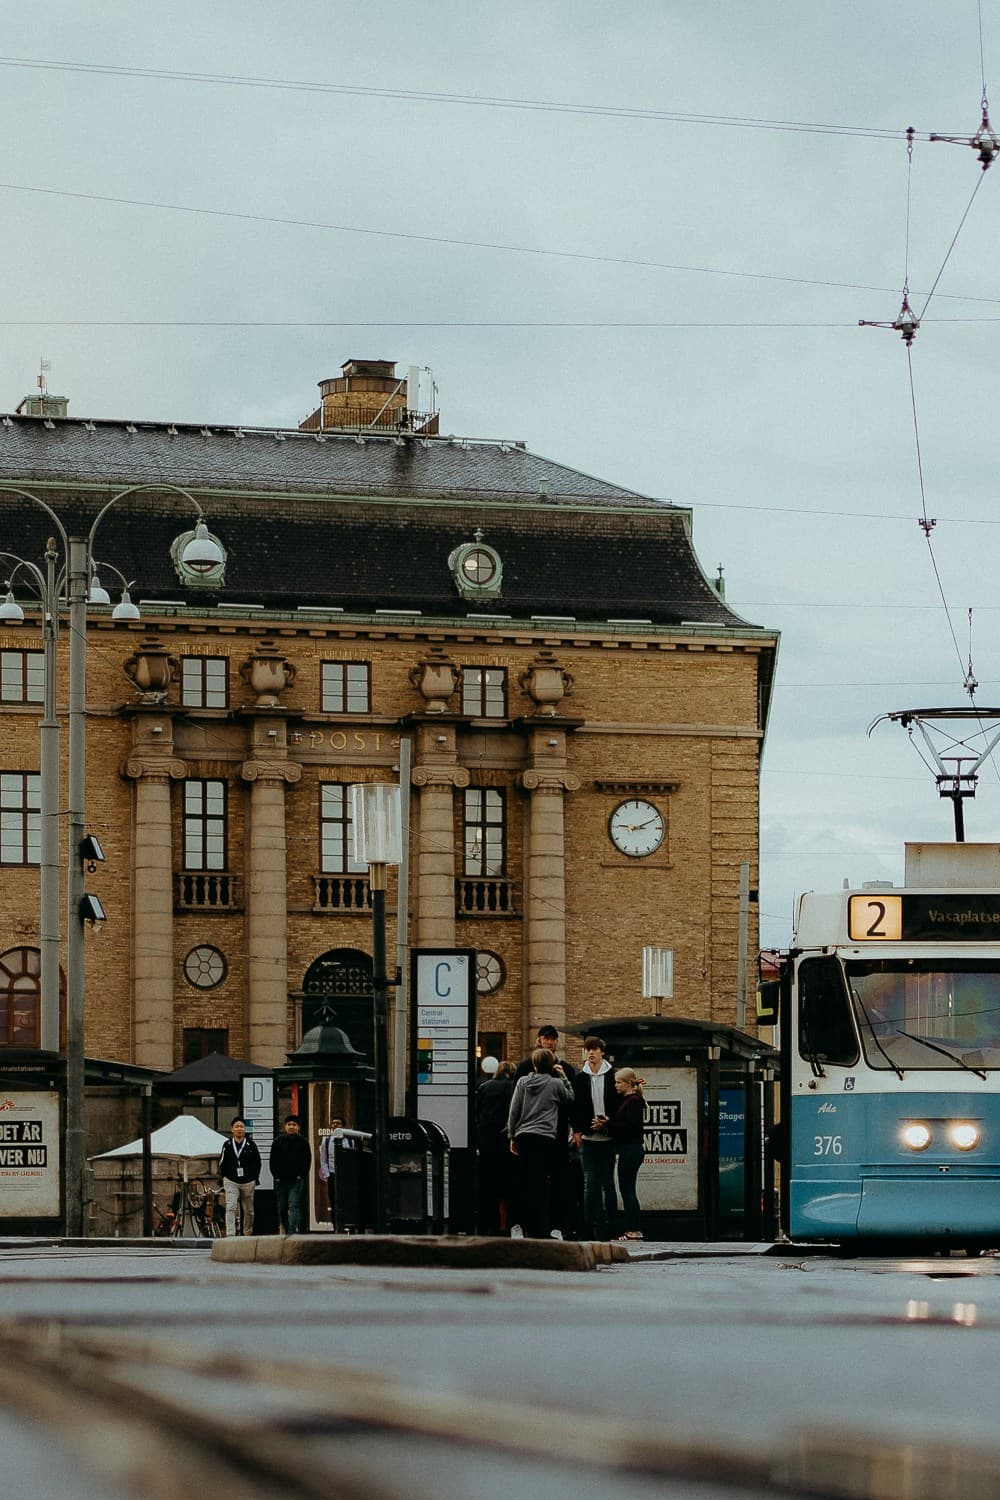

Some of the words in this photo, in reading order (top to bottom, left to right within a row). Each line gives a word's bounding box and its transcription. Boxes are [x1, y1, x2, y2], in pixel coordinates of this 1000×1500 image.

[310, 730, 385, 751] POST
[866, 901, 887, 937] 2
[435, 962, 451, 997] C
[252, 1081, 264, 1102] D
[22, 1122, 41, 1141] ÄR
[642, 1130, 684, 1152] NÄRA
[814, 1135, 842, 1155] 376
[27, 1149, 46, 1165] NU
